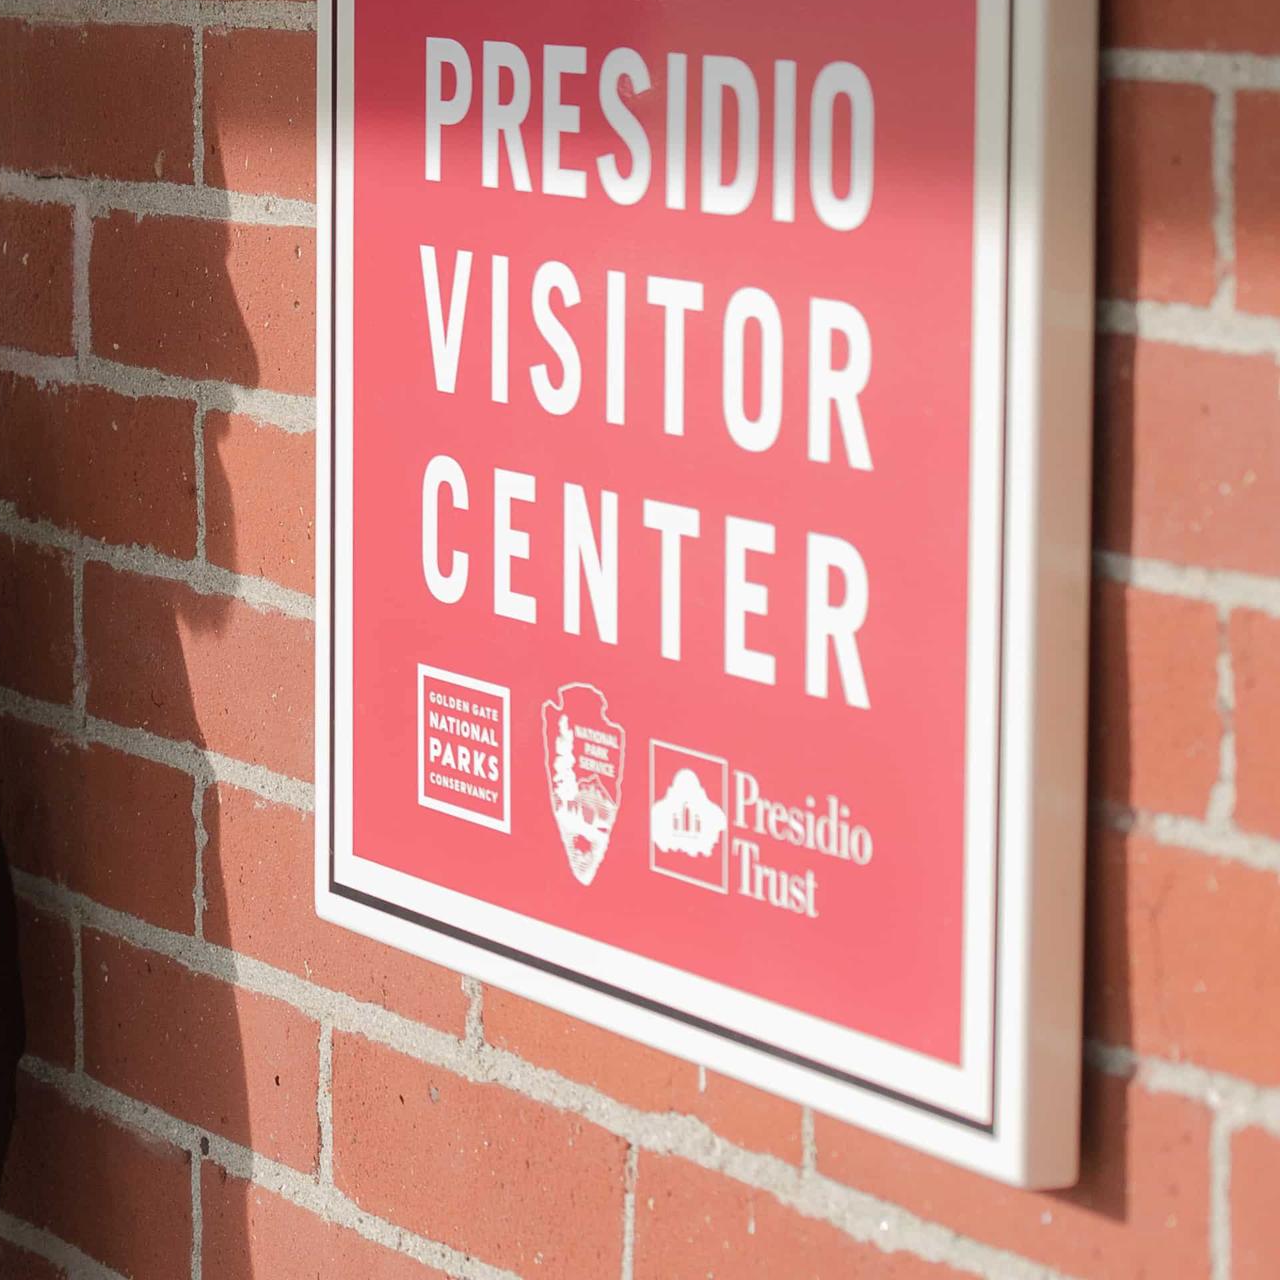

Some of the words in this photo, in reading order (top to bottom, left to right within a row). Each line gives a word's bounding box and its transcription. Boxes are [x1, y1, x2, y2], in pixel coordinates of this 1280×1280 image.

[425, 36, 874, 231] PRESIDIO
[419, 245, 874, 472] VISITOR
[421, 454, 871, 709] CENTER
[429, 691, 470, 713] GOLDEN
[472, 703, 500, 722] GATE
[429, 711, 500, 747] NATIONAL
[429, 736, 500, 782] PARKS
[429, 772, 499, 803] CONSERVANCY
[732, 770, 873, 866] Presidio
[732, 838, 819, 918] Trust
